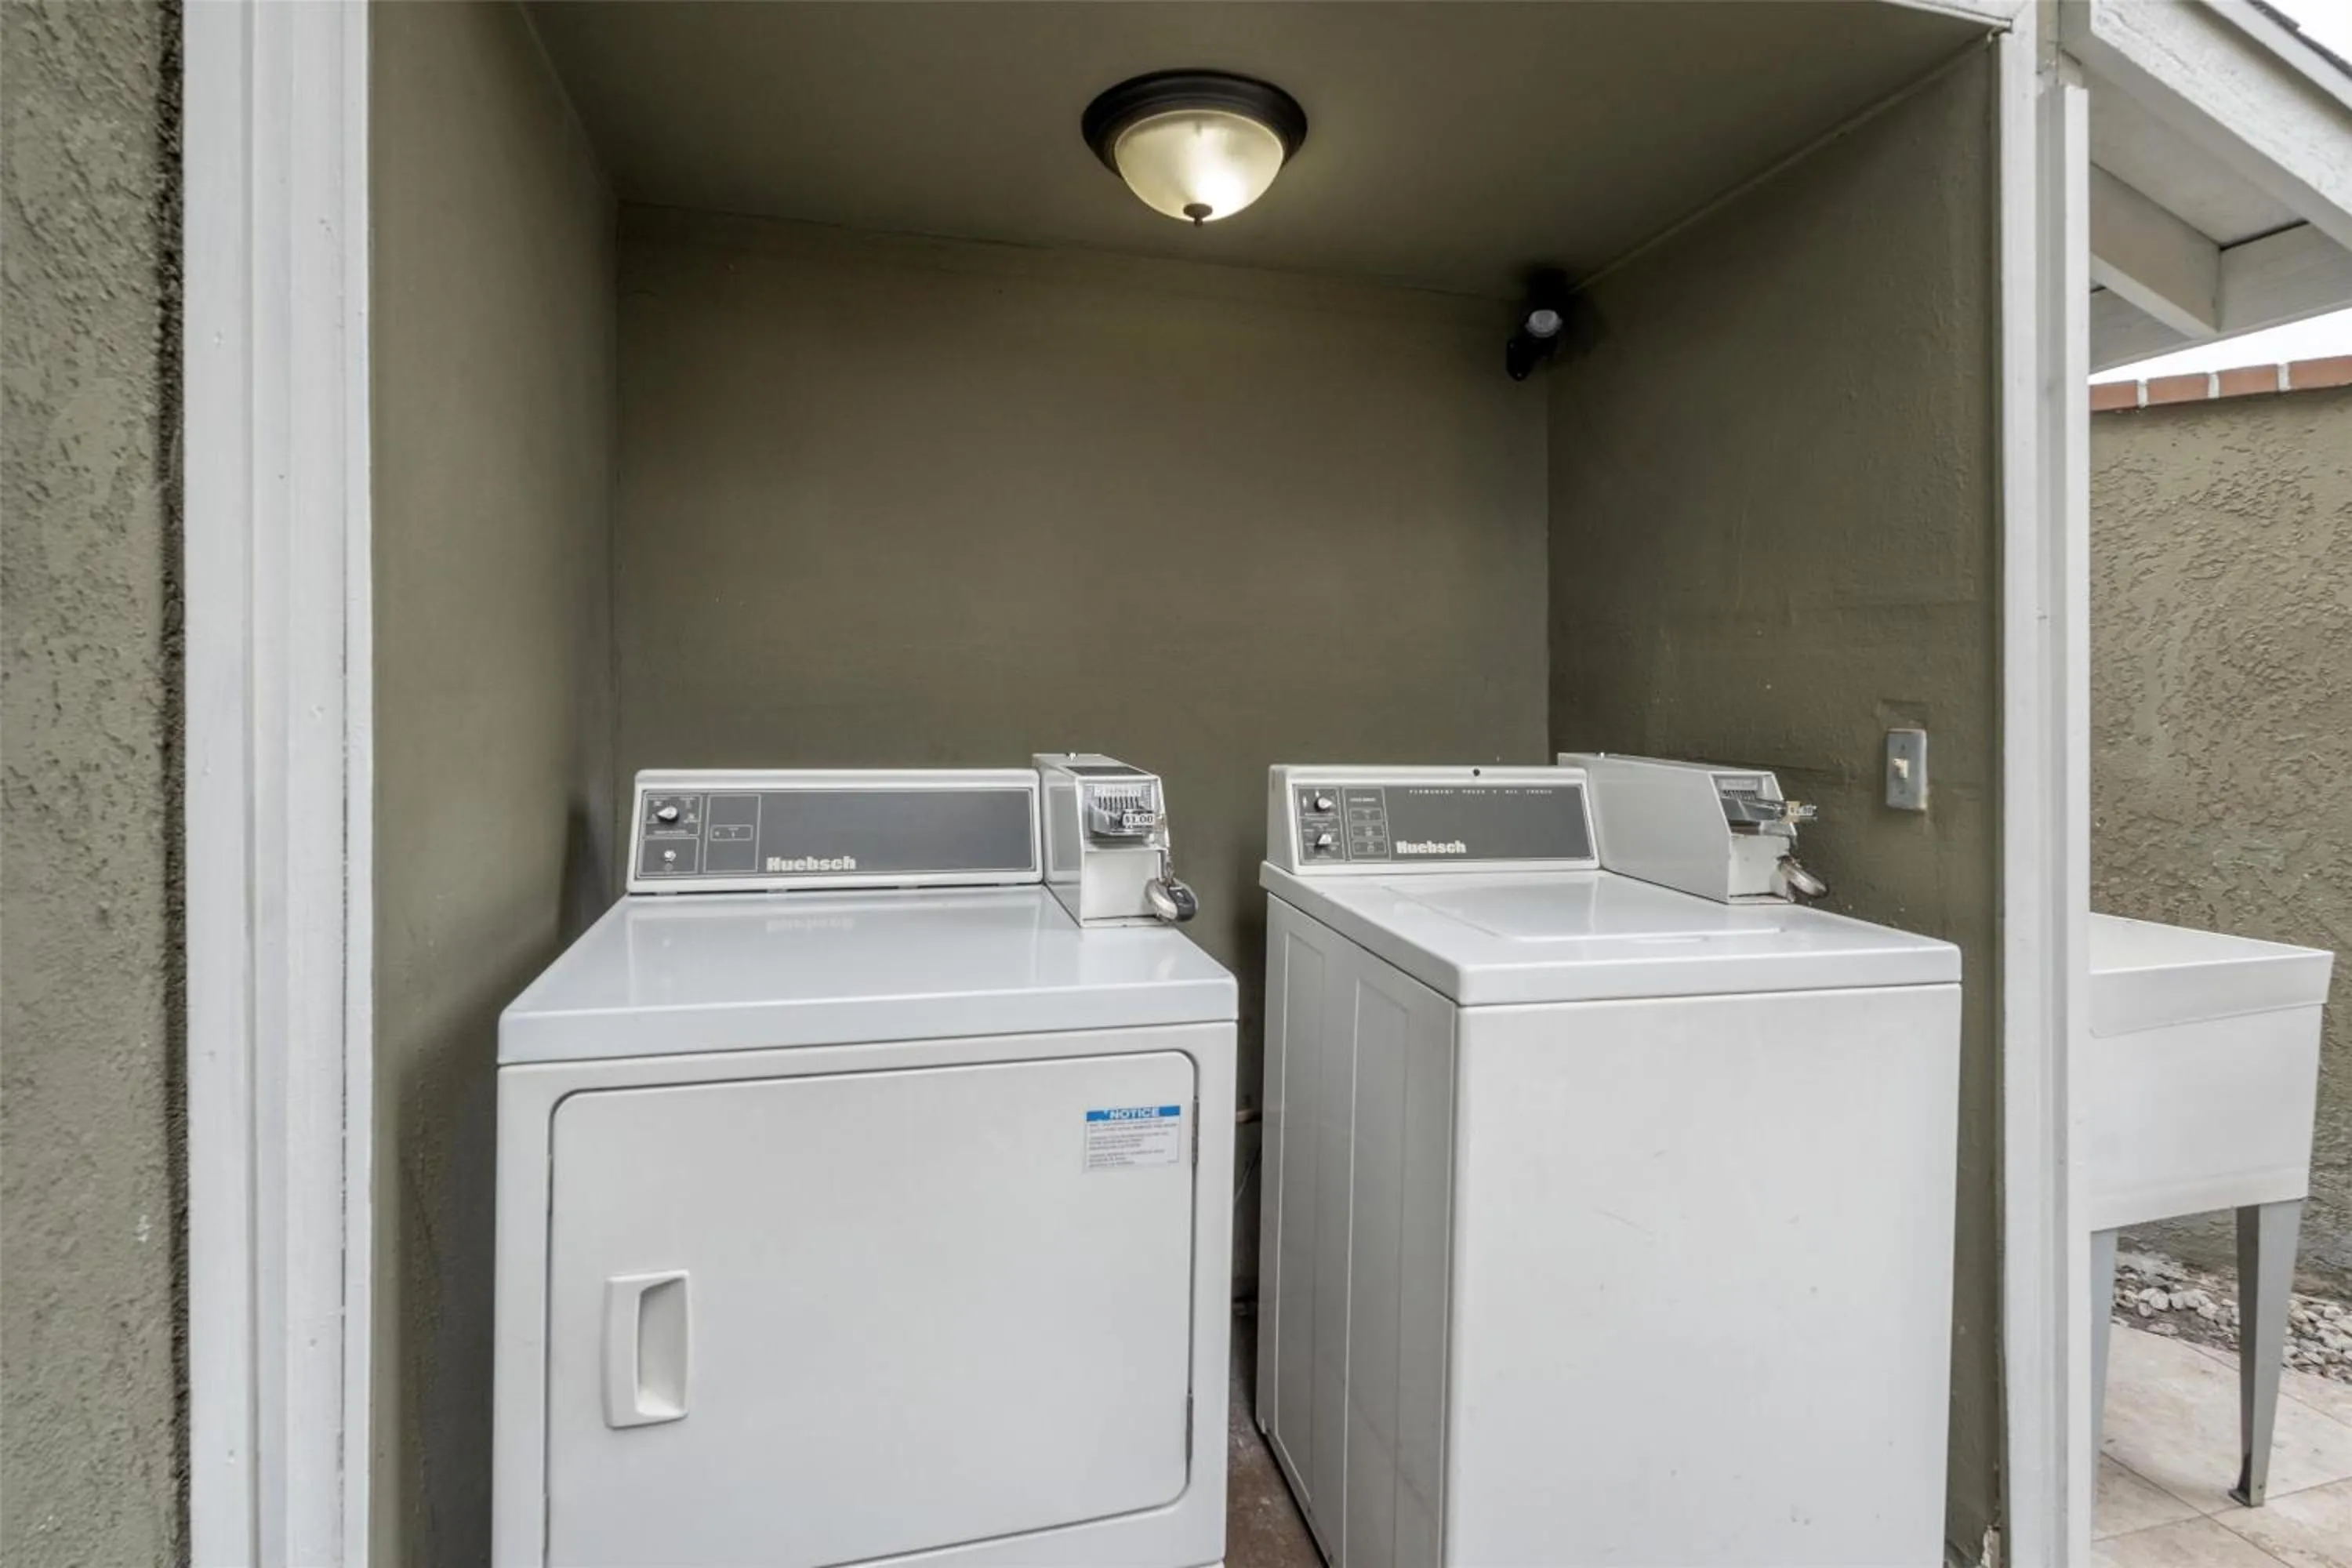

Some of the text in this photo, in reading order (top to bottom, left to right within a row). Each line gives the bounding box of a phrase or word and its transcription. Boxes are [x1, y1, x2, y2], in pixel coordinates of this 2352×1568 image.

[1396, 840, 1466, 854] Huebsch
[767, 856, 856, 872] Huebsch
[1109, 1107, 1160, 1120] NOTICE
